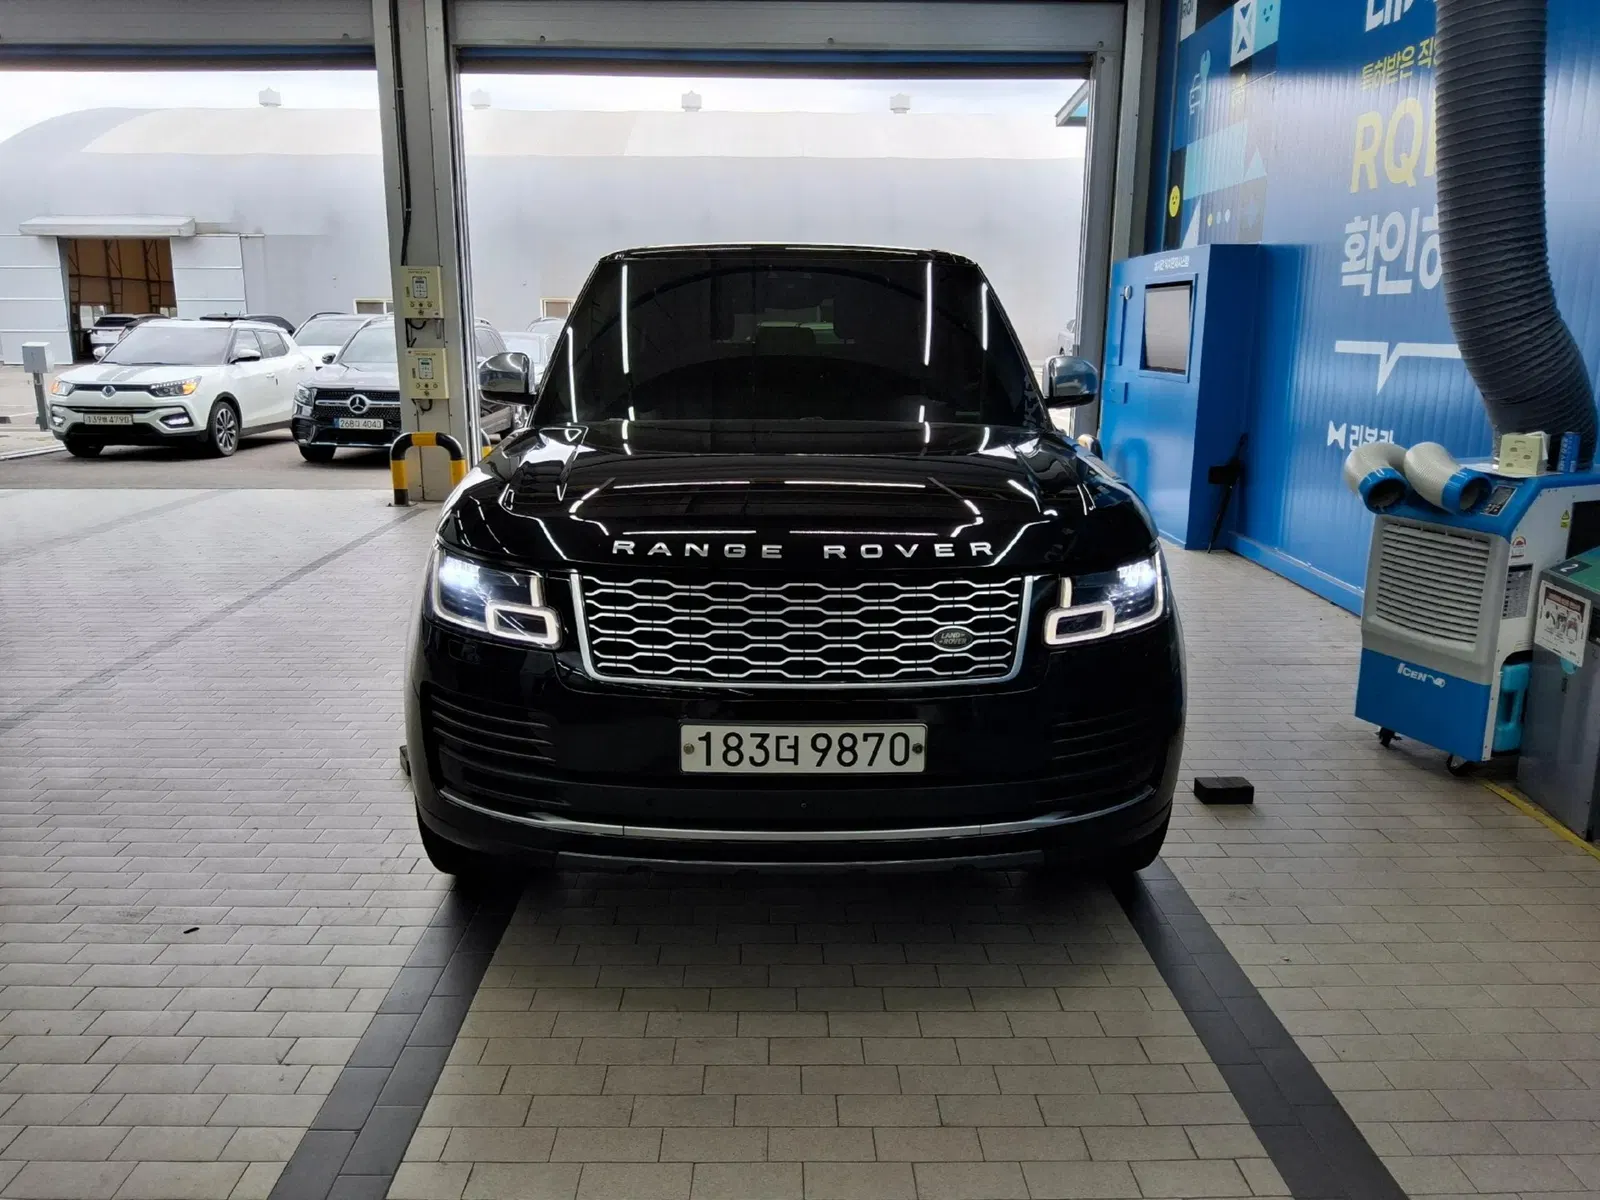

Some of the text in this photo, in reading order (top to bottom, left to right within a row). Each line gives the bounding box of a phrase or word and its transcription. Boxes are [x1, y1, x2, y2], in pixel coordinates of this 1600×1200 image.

[1417, 36, 1437, 70] 직
[611, 539, 994, 560] RANGE ROVER
[941, 631, 961, 639] LAND
[943, 638, 967, 646] ROVER
[697, 730, 911, 768] 183더 9870
